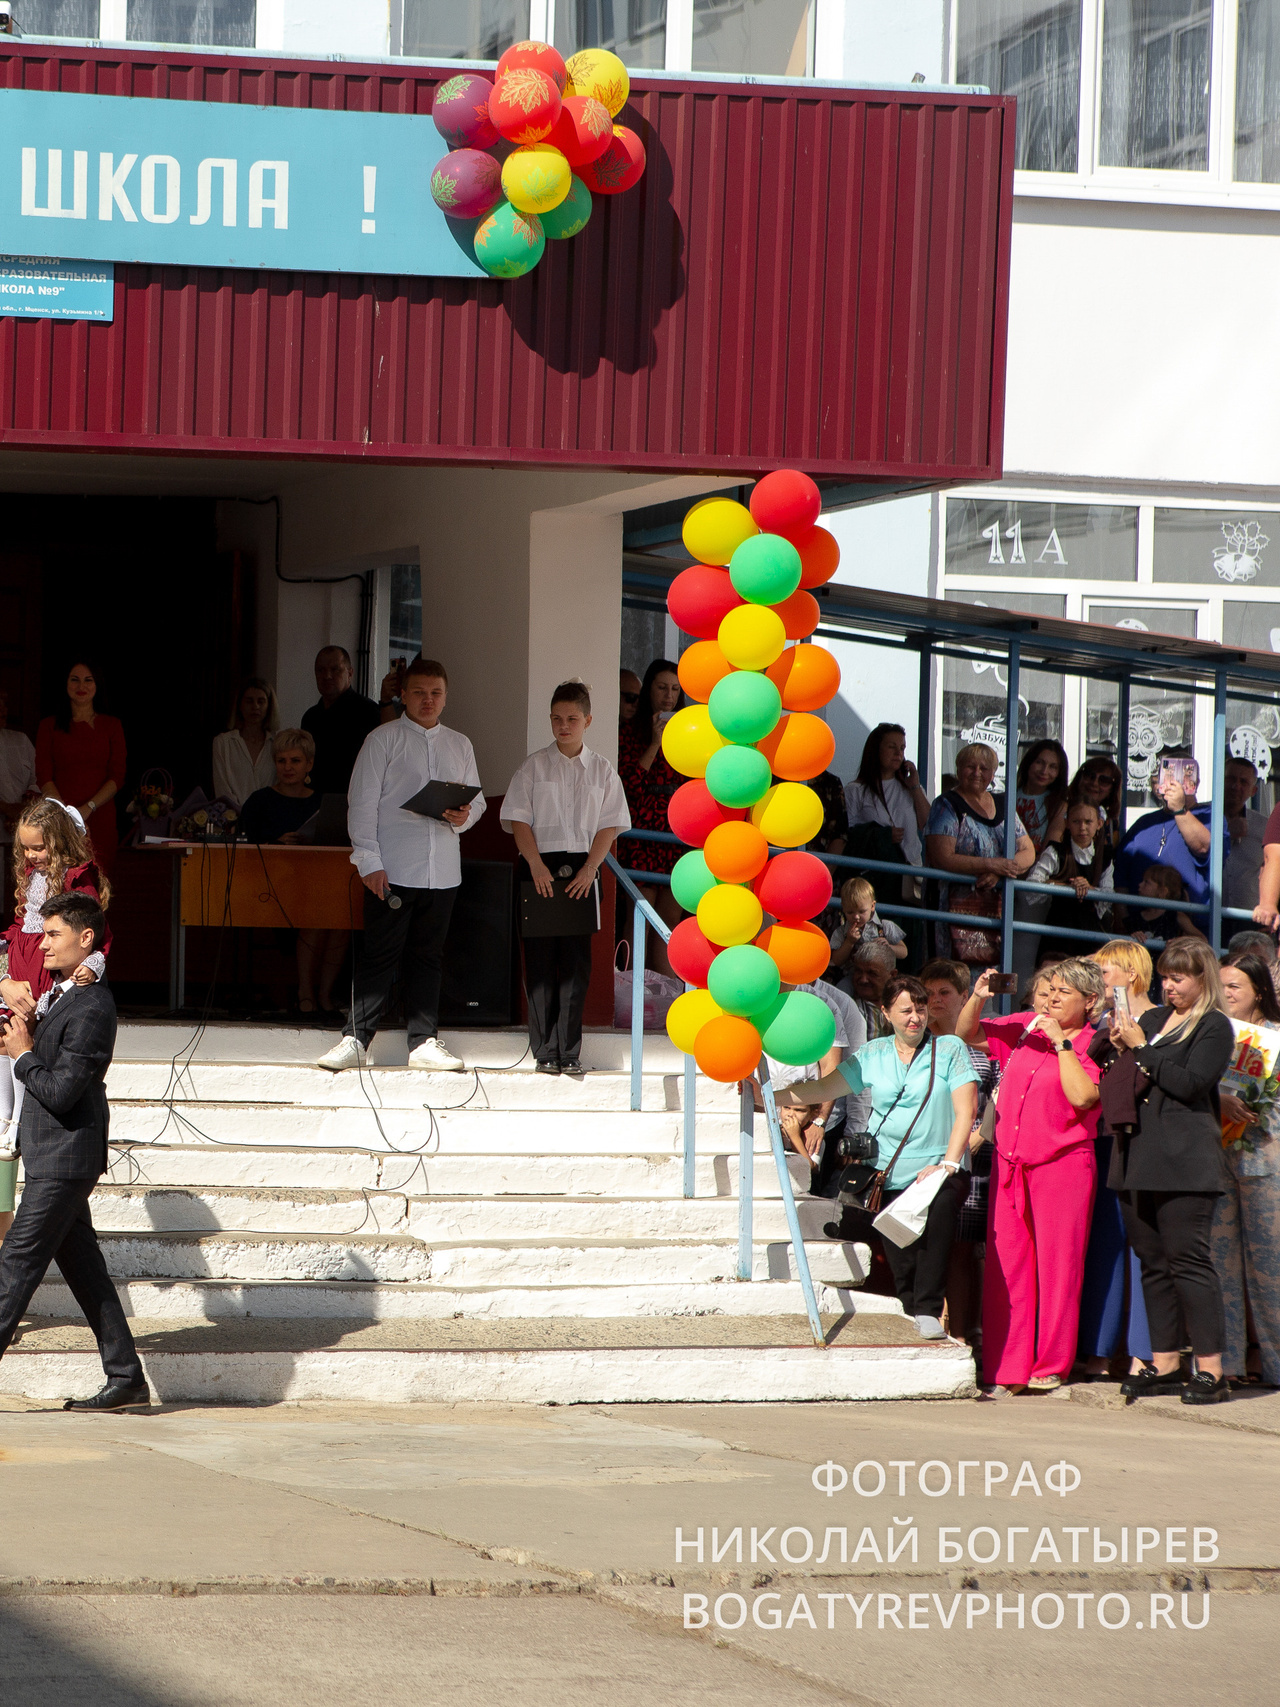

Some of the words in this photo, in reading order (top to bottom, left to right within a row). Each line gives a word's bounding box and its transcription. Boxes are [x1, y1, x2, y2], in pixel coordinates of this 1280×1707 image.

[21, 147, 290, 231] ШКОЛА
[361, 165, 378, 234] !
[982, 519, 1027, 564] 11
[975, 732, 1006, 746] АЗБУК
